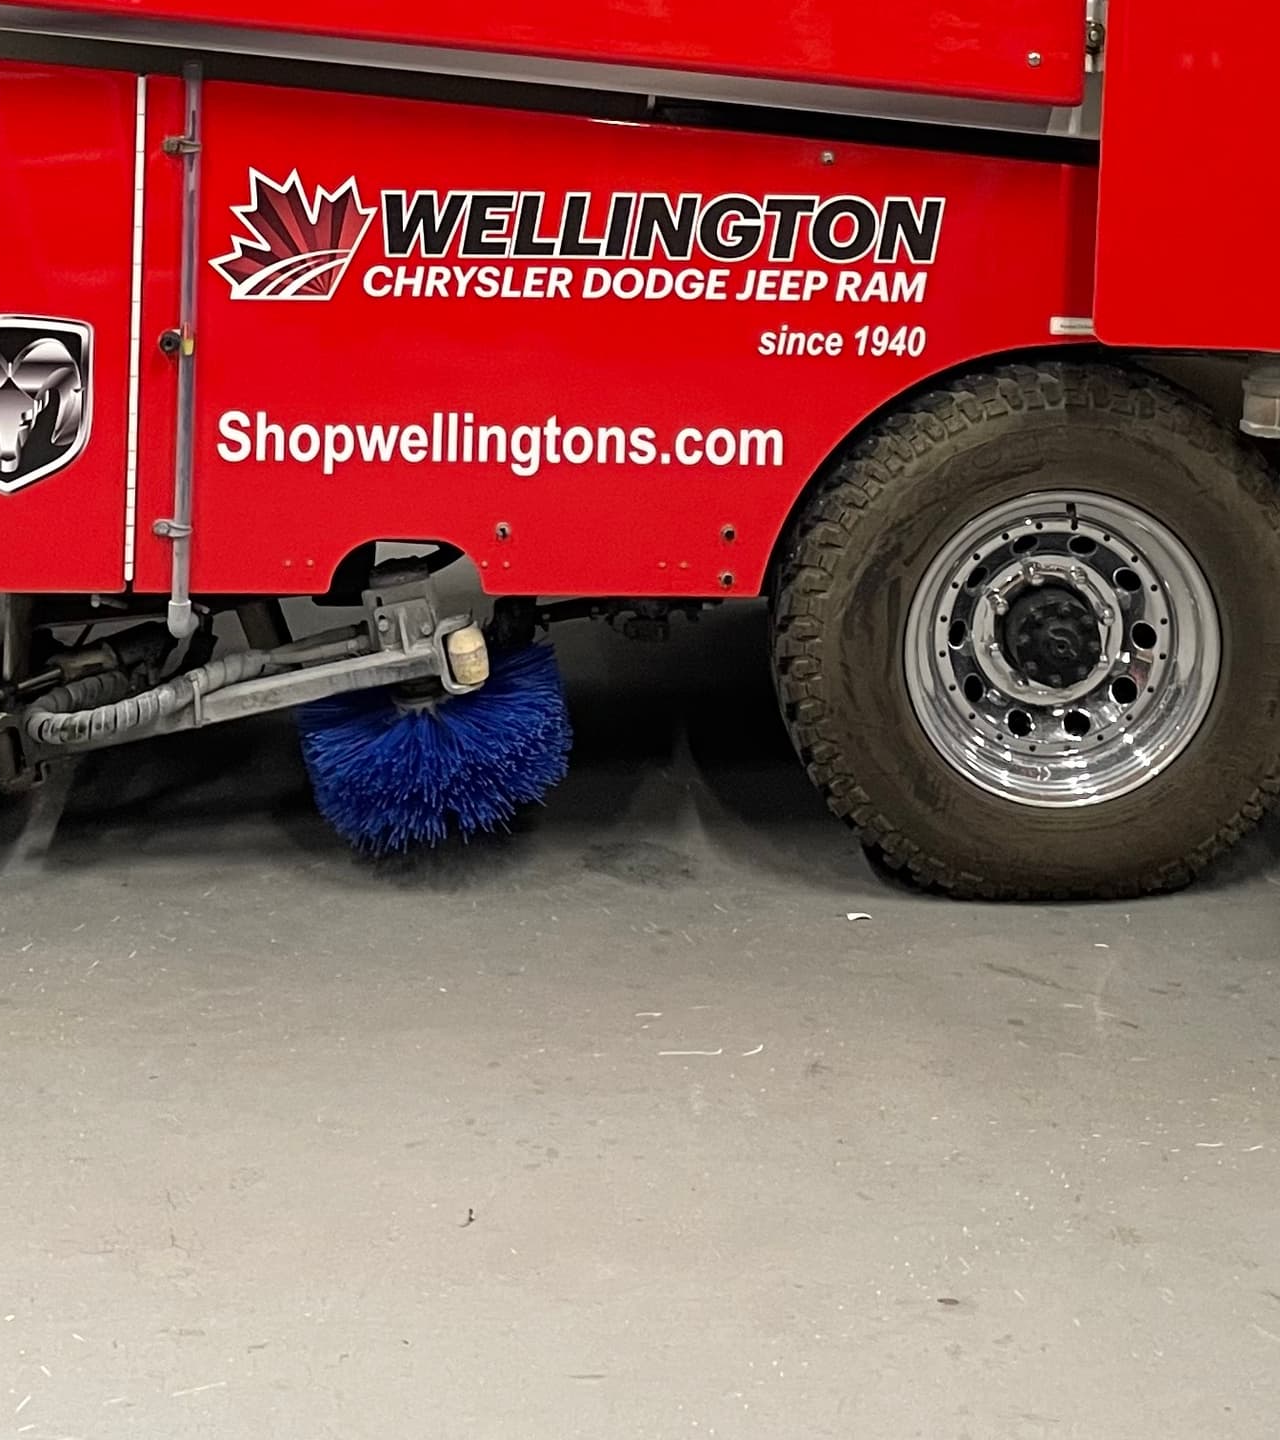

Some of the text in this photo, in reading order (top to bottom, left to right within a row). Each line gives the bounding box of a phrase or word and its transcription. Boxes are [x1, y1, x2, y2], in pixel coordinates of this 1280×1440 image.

[376, 190, 946, 264] WELLINGTON
[362, 266, 928, 303] CHRYSLER DODGE JEEP RAM
[757, 325, 927, 358] since 1940
[216, 410, 785, 476] Shopwellingtons.com
